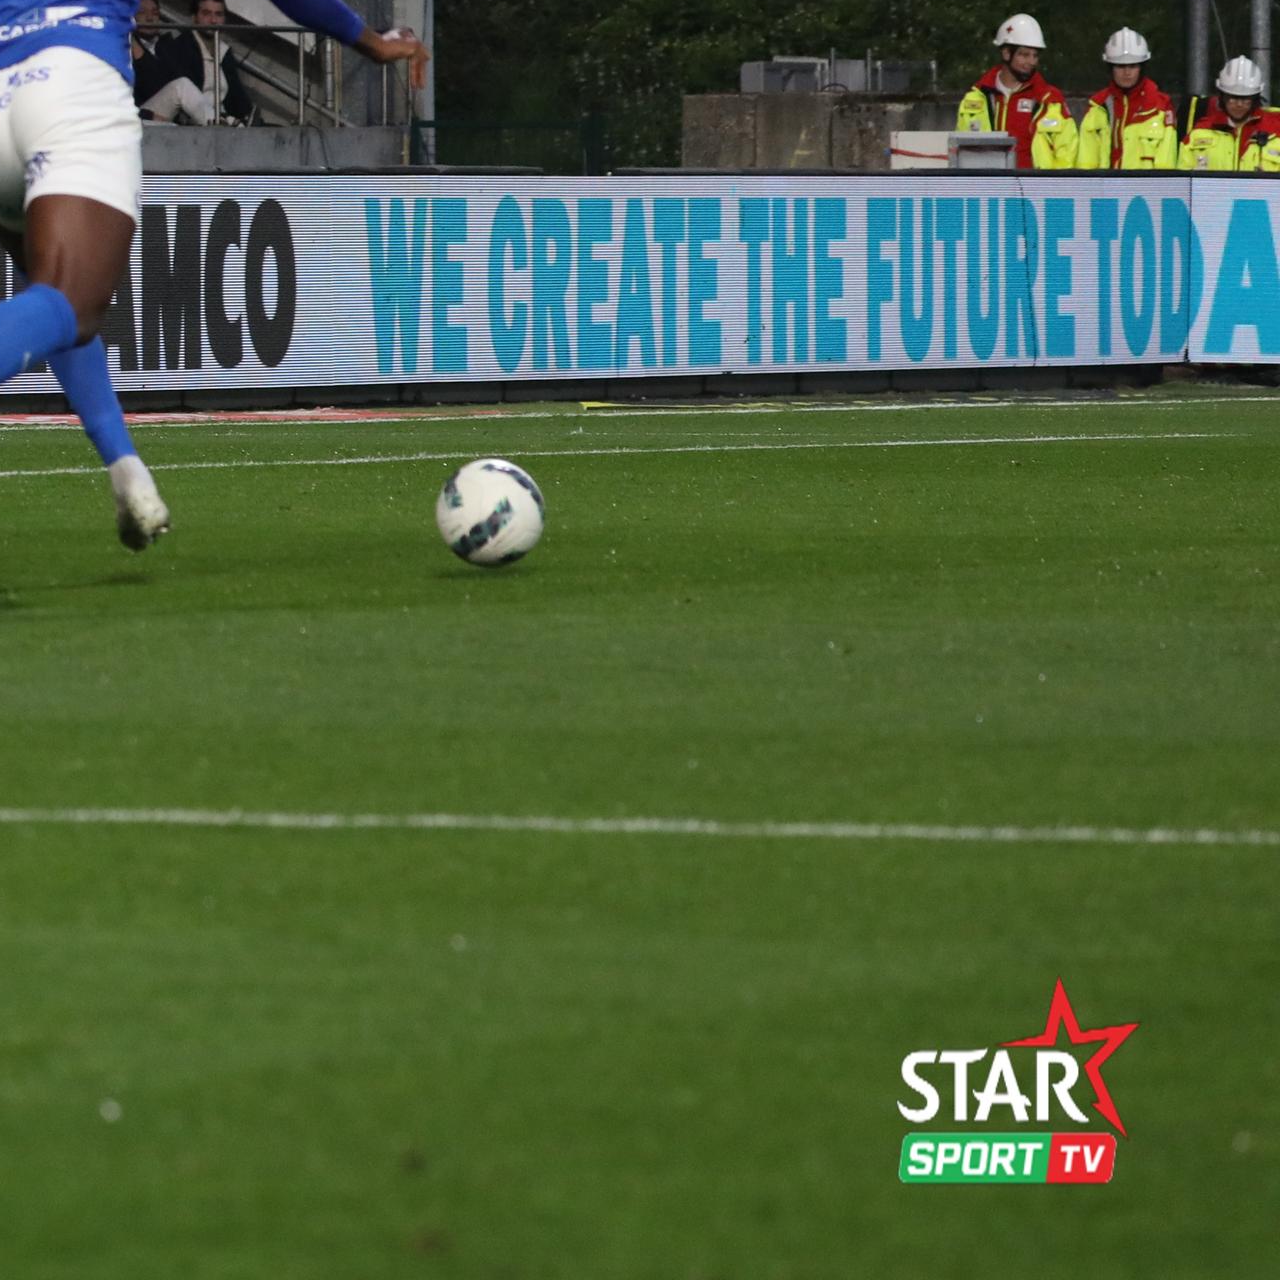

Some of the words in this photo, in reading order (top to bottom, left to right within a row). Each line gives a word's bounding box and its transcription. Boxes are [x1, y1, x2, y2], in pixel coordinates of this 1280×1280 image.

[364, 197, 468, 375] WE
[487, 193, 722, 374] CREATE
[739, 197, 847, 365] THE
[867, 197, 1075, 362] FUTURE
